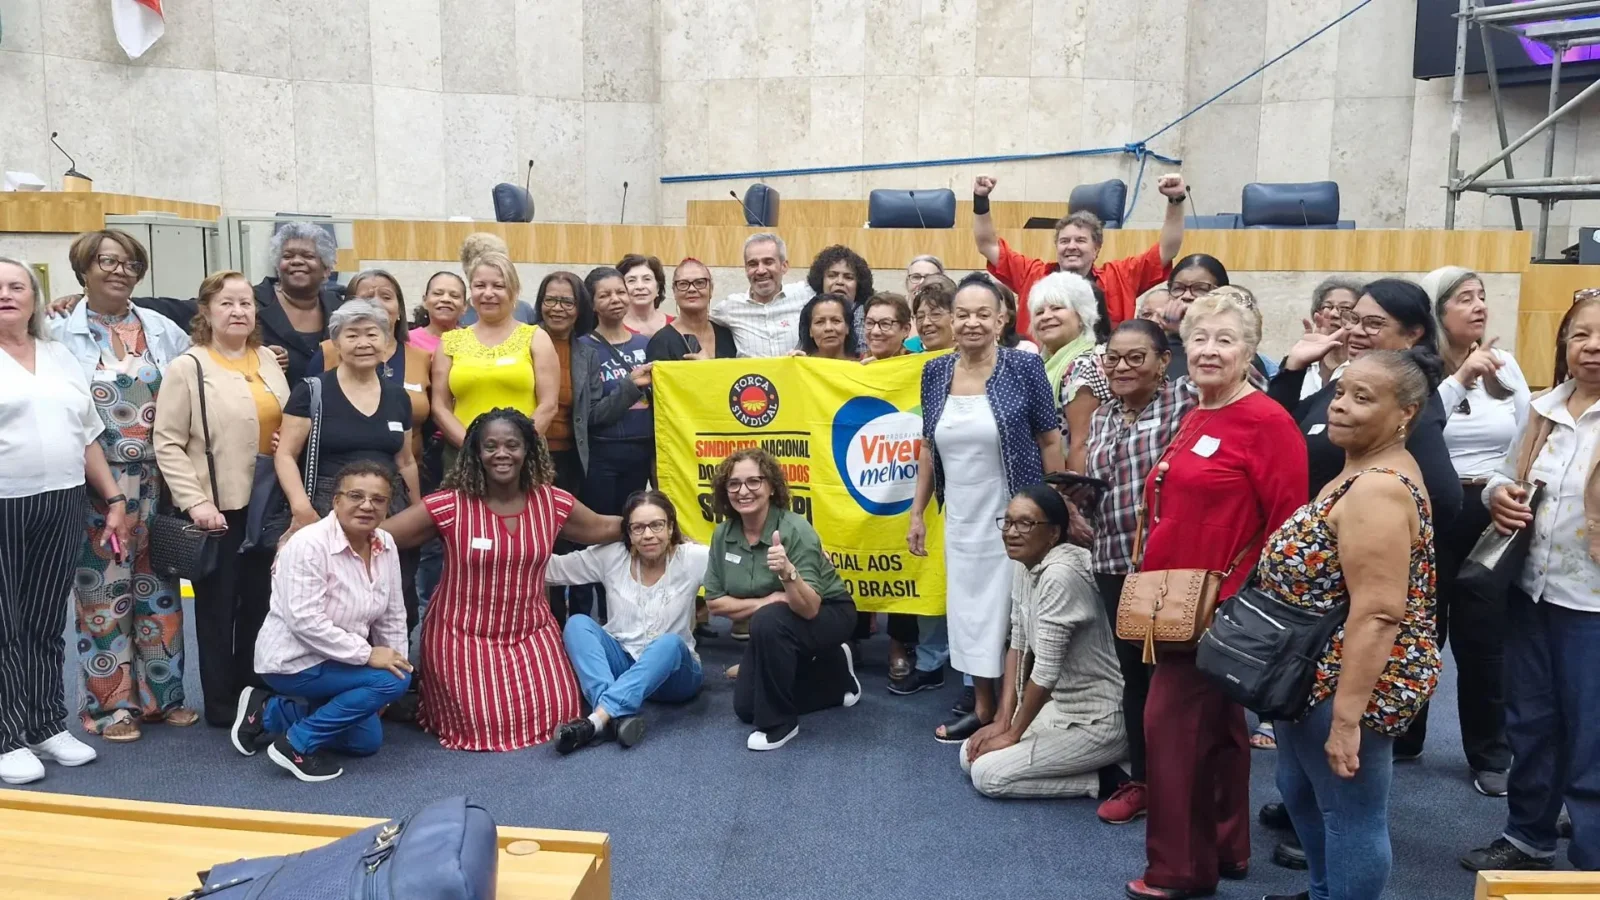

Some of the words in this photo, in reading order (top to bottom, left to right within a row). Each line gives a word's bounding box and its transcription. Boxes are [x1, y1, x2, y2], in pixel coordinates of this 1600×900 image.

[734, 376, 769, 392] FORÇA
[732, 403, 777, 426] SINDICAL
[761, 439, 810, 458] NACIONAL
[826, 551, 863, 571] CIAL
[868, 554, 903, 571] AOS
[858, 580, 920, 598] BRASIL
